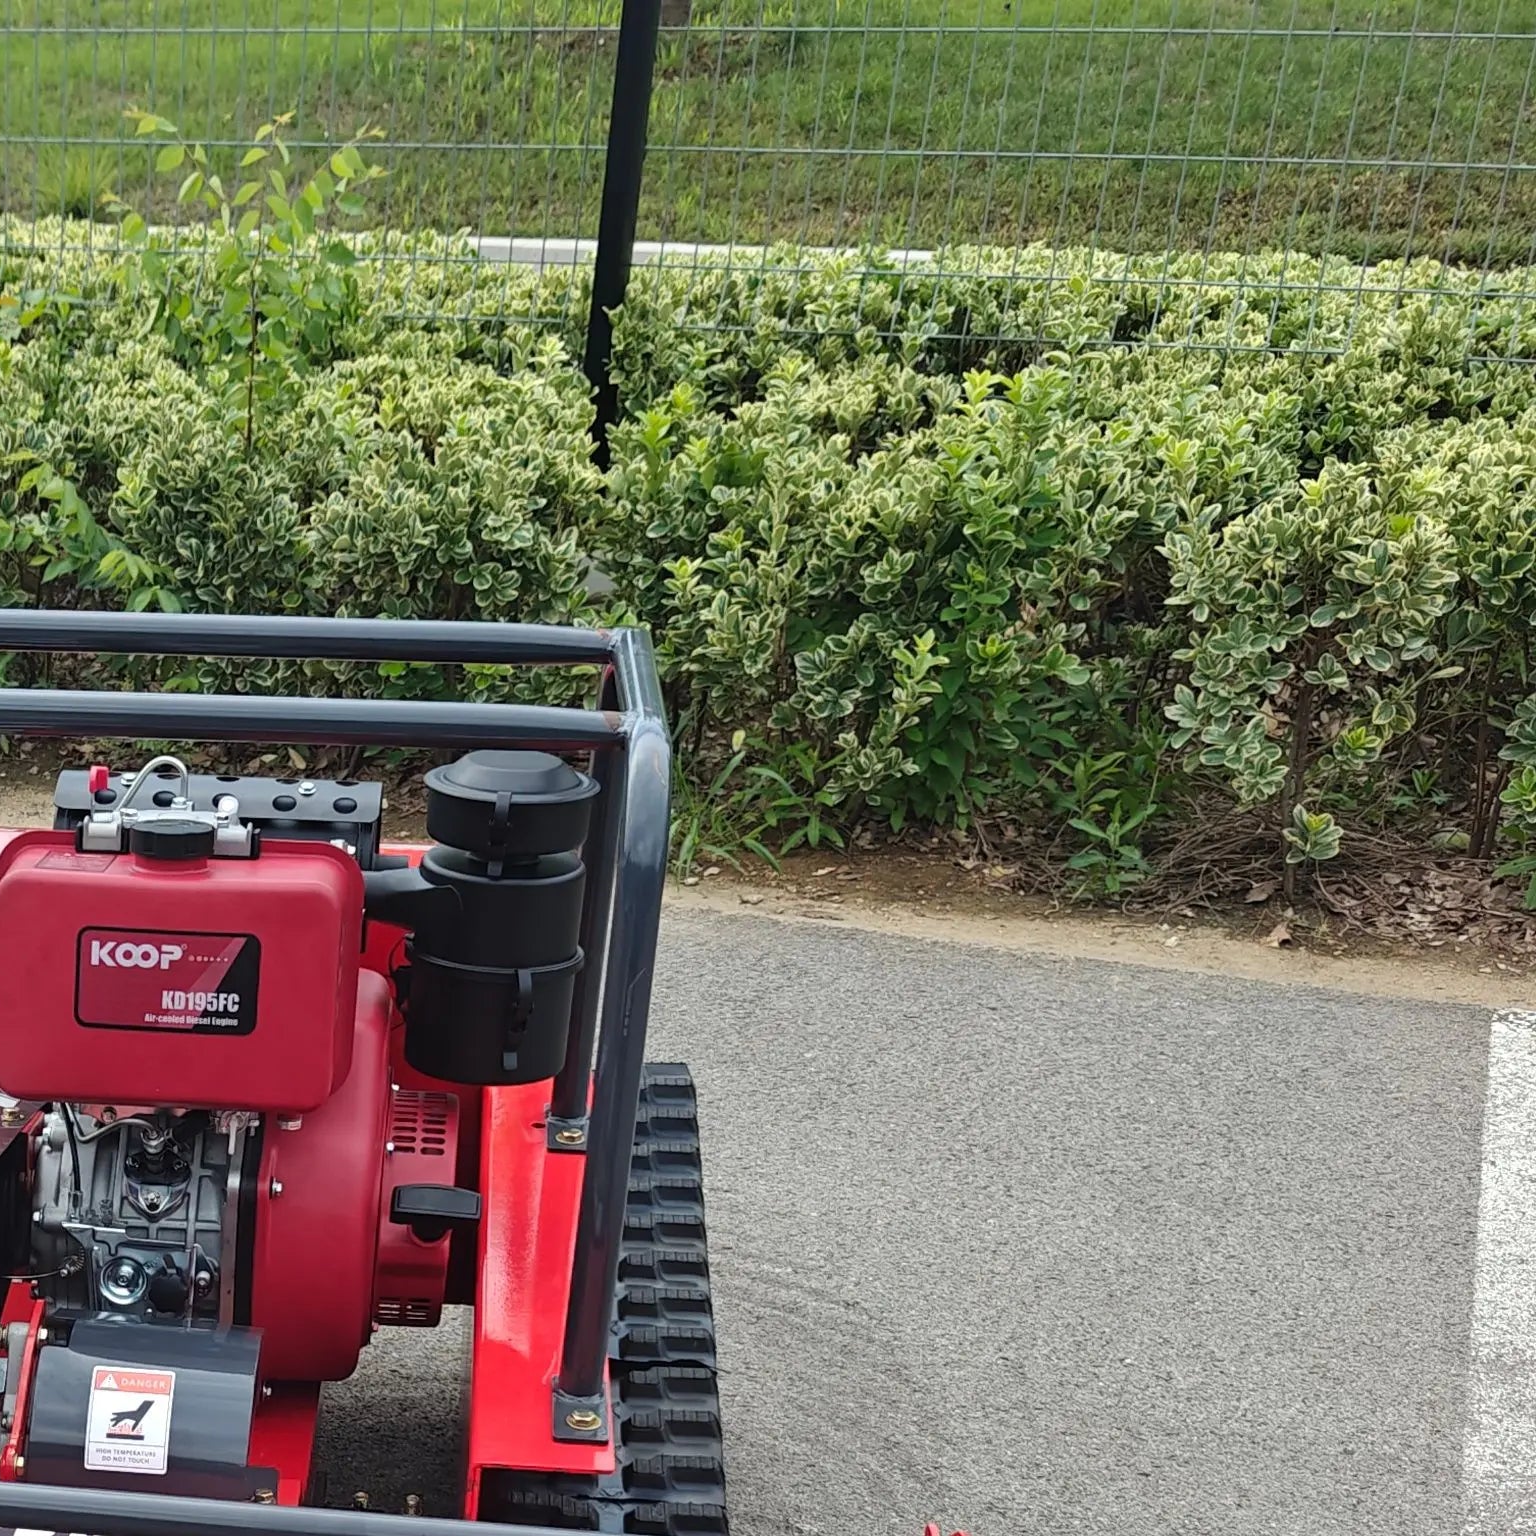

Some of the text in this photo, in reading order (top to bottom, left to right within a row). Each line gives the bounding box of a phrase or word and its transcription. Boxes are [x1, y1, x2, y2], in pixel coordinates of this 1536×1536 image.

[90, 940, 184, 970] KOOP
[161, 990, 240, 1012] KD195FC
[144, 1013, 238, 1026] Air-cooled Diesel Engine
[121, 1378, 166, 1389] DANGER
[113, 1449, 156, 1457] TEMPERATURE
